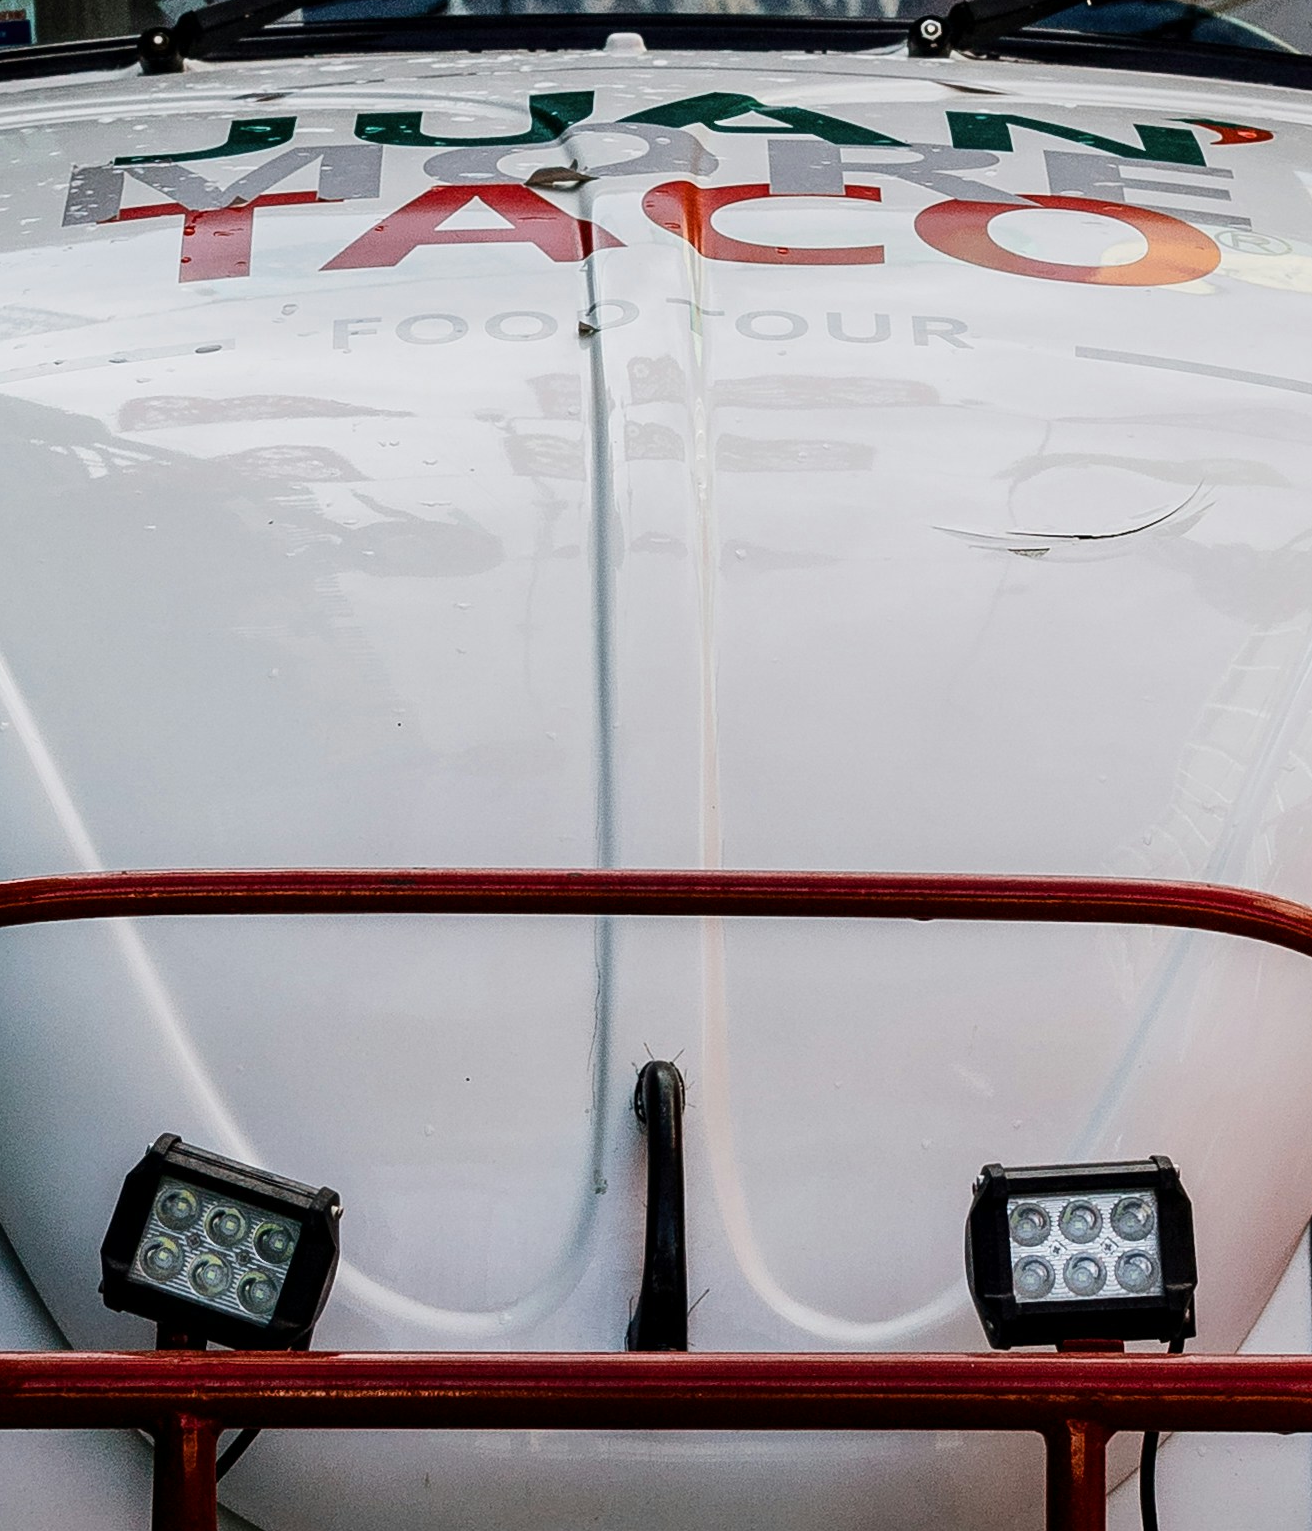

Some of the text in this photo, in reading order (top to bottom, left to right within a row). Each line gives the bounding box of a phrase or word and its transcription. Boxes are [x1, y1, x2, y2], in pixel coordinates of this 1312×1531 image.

[62, 121, 1253, 232] MORE
[97, 180, 1222, 287] TACO
[332, 296, 975, 351] FOOD TOUR
